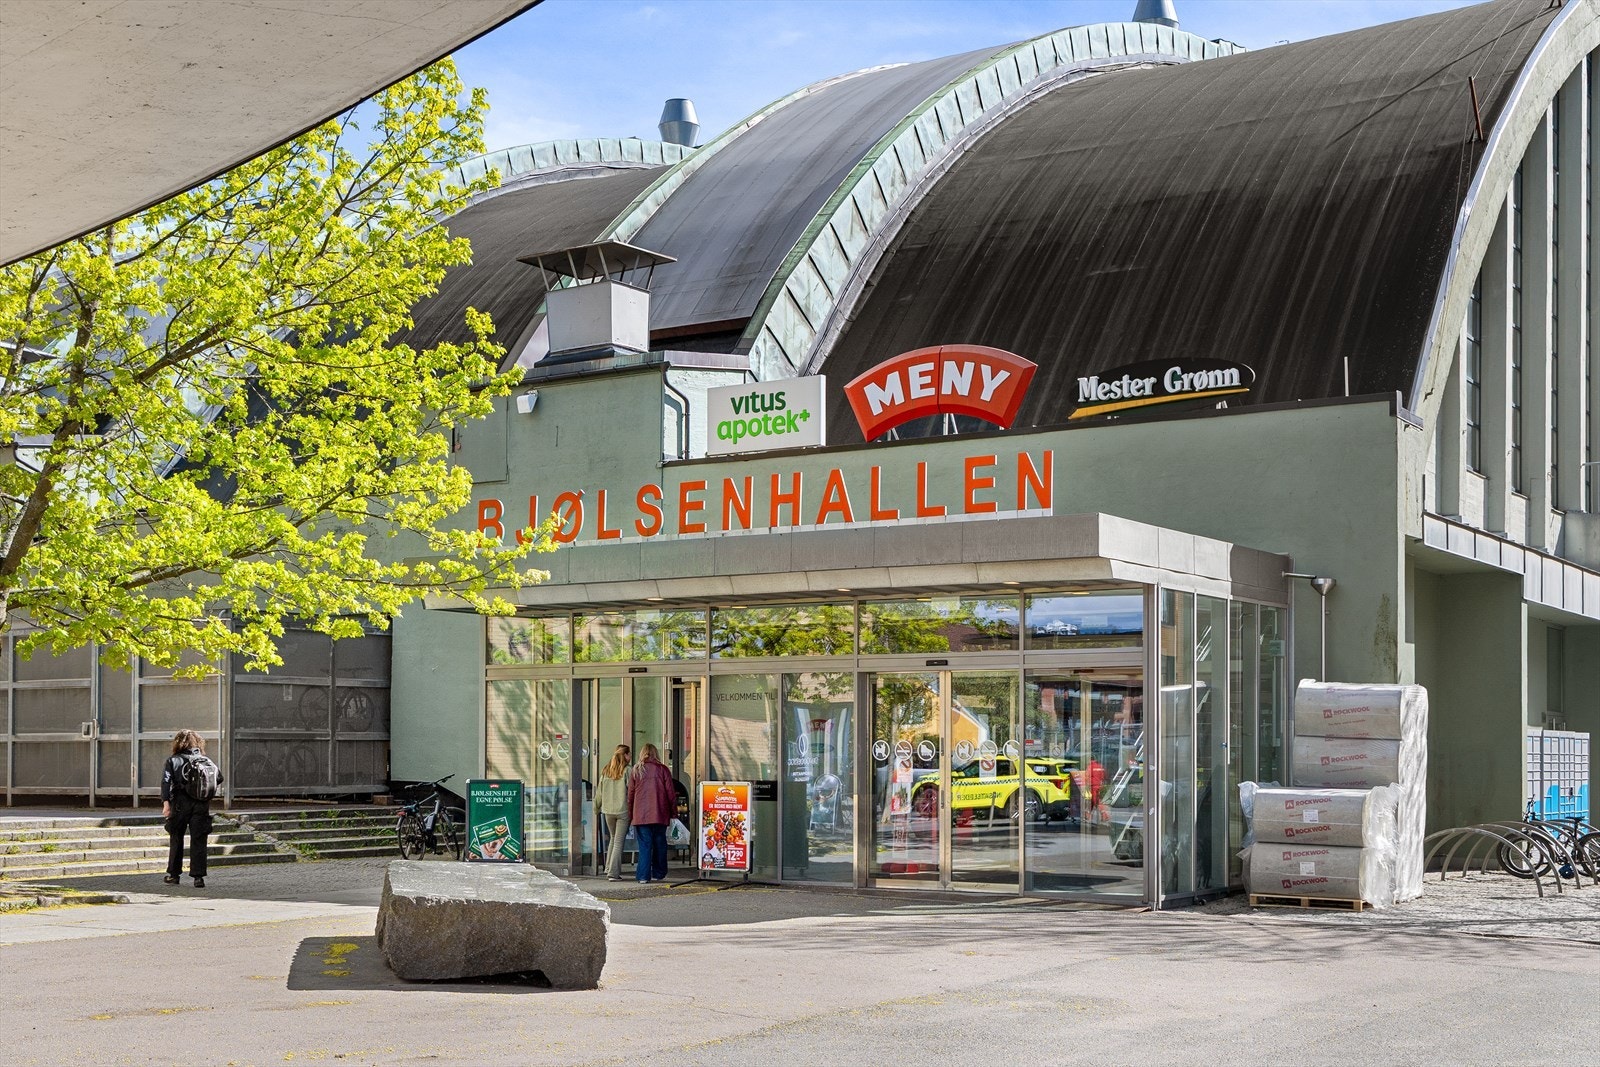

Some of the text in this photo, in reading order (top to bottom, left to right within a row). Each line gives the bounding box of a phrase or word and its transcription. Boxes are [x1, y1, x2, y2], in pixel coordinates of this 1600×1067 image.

[864, 360, 1011, 416] MENY
[1077, 366, 1241, 402] Mester Grønn
[730, 389, 786, 414] vitus
[477, 450, 1053, 546] BJØLSENHALLEN
[716, 691, 775, 702] VELKOMMEN TIL
[1333, 706, 1370, 716] ROCKWOOL
[1331, 754, 1368, 763] ROCKWOOL
[1295, 797, 1332, 806] ROCKWOOL
[1295, 825, 1331, 834] ROCKWOOL
[1293, 849, 1329, 858] ROCKWOOL
[1292, 877, 1328, 886] ROCKWOOL
